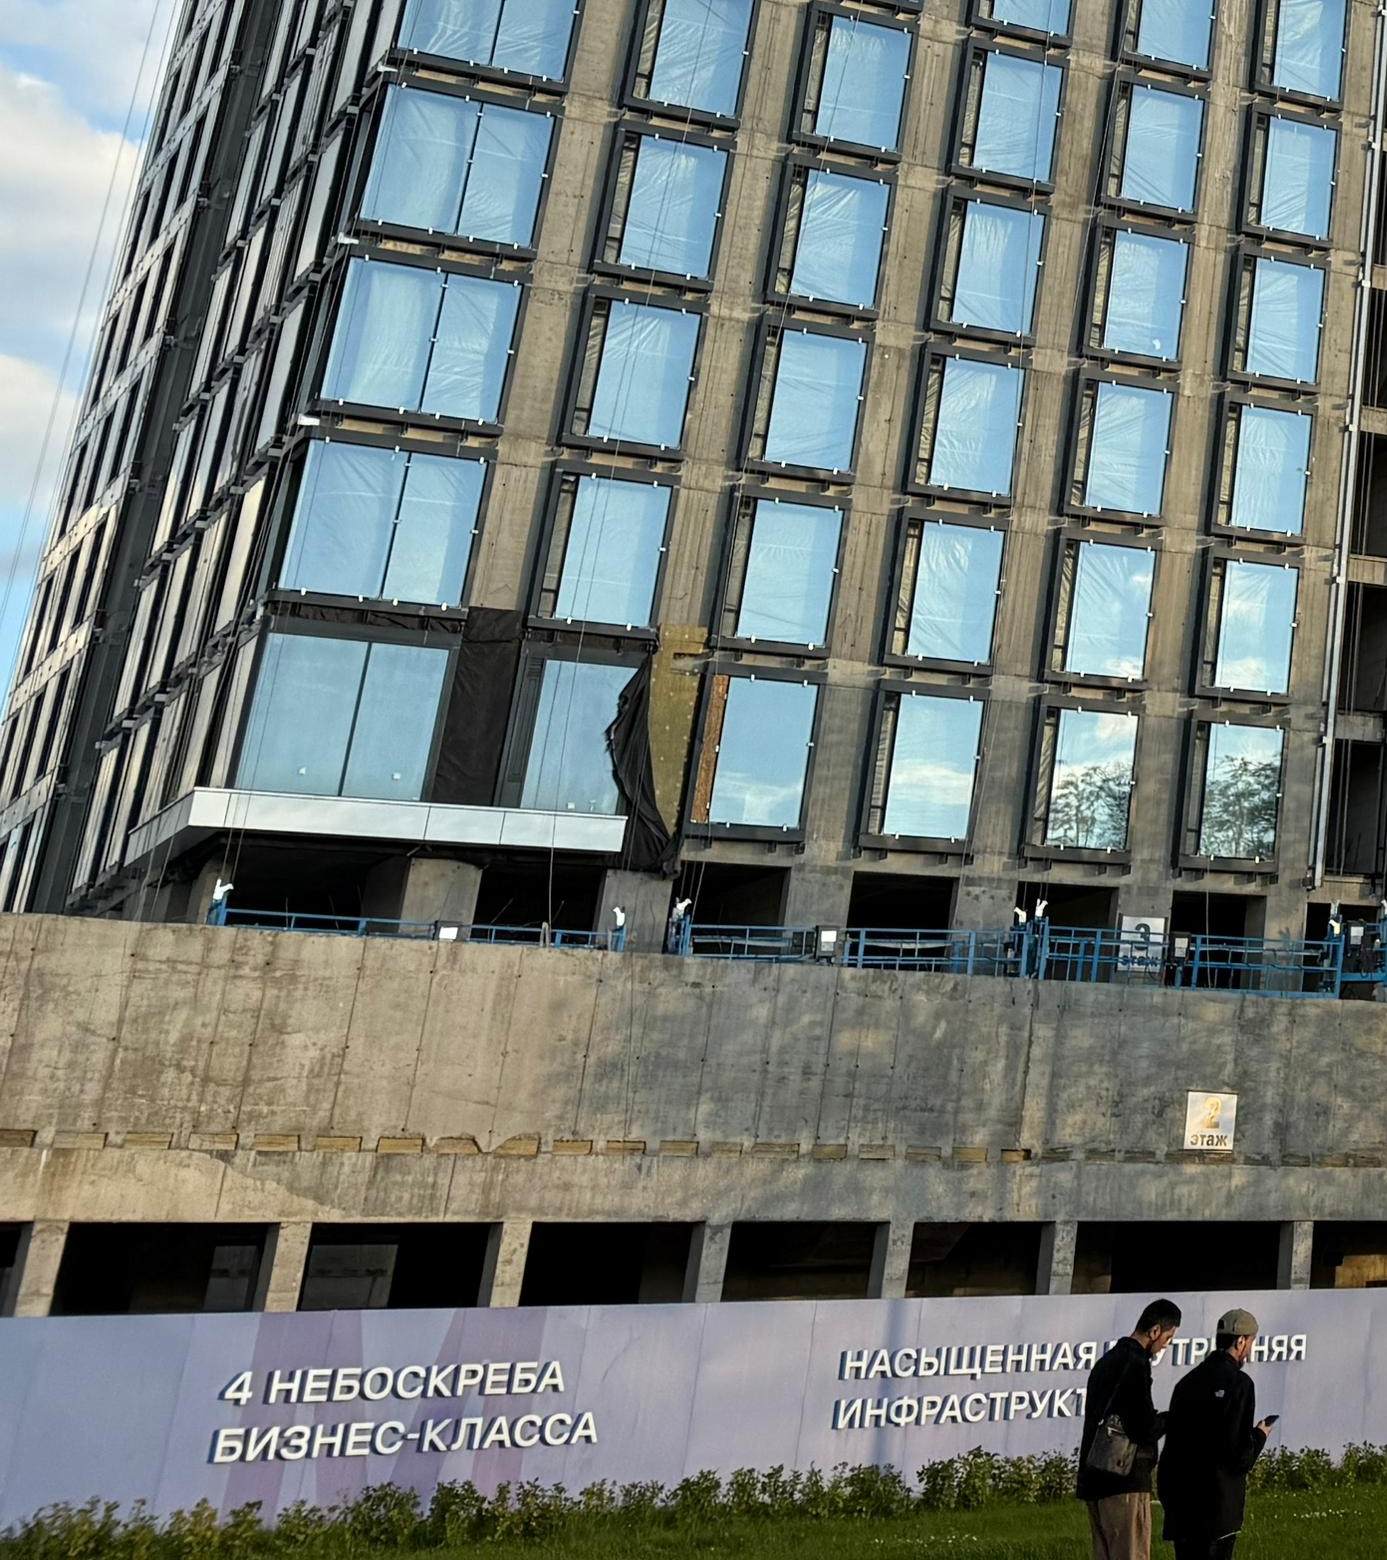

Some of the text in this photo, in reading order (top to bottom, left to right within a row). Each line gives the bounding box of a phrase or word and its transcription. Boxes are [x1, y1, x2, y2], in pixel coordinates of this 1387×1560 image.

[1135, 922, 1151, 951] 3
[1204, 1096, 1222, 1129] 2
[1190, 1134, 1228, 1147] этаж
[842, 1341, 1096, 1381] НАСЫЩЕННАЯ
[224, 1360, 565, 1406] 4 НЕБОСКРЕБА
[835, 1387, 1087, 1430] ИНФРАСТРУКТ
[211, 1412, 598, 1464] БИЗНЕС-КЛАССА
